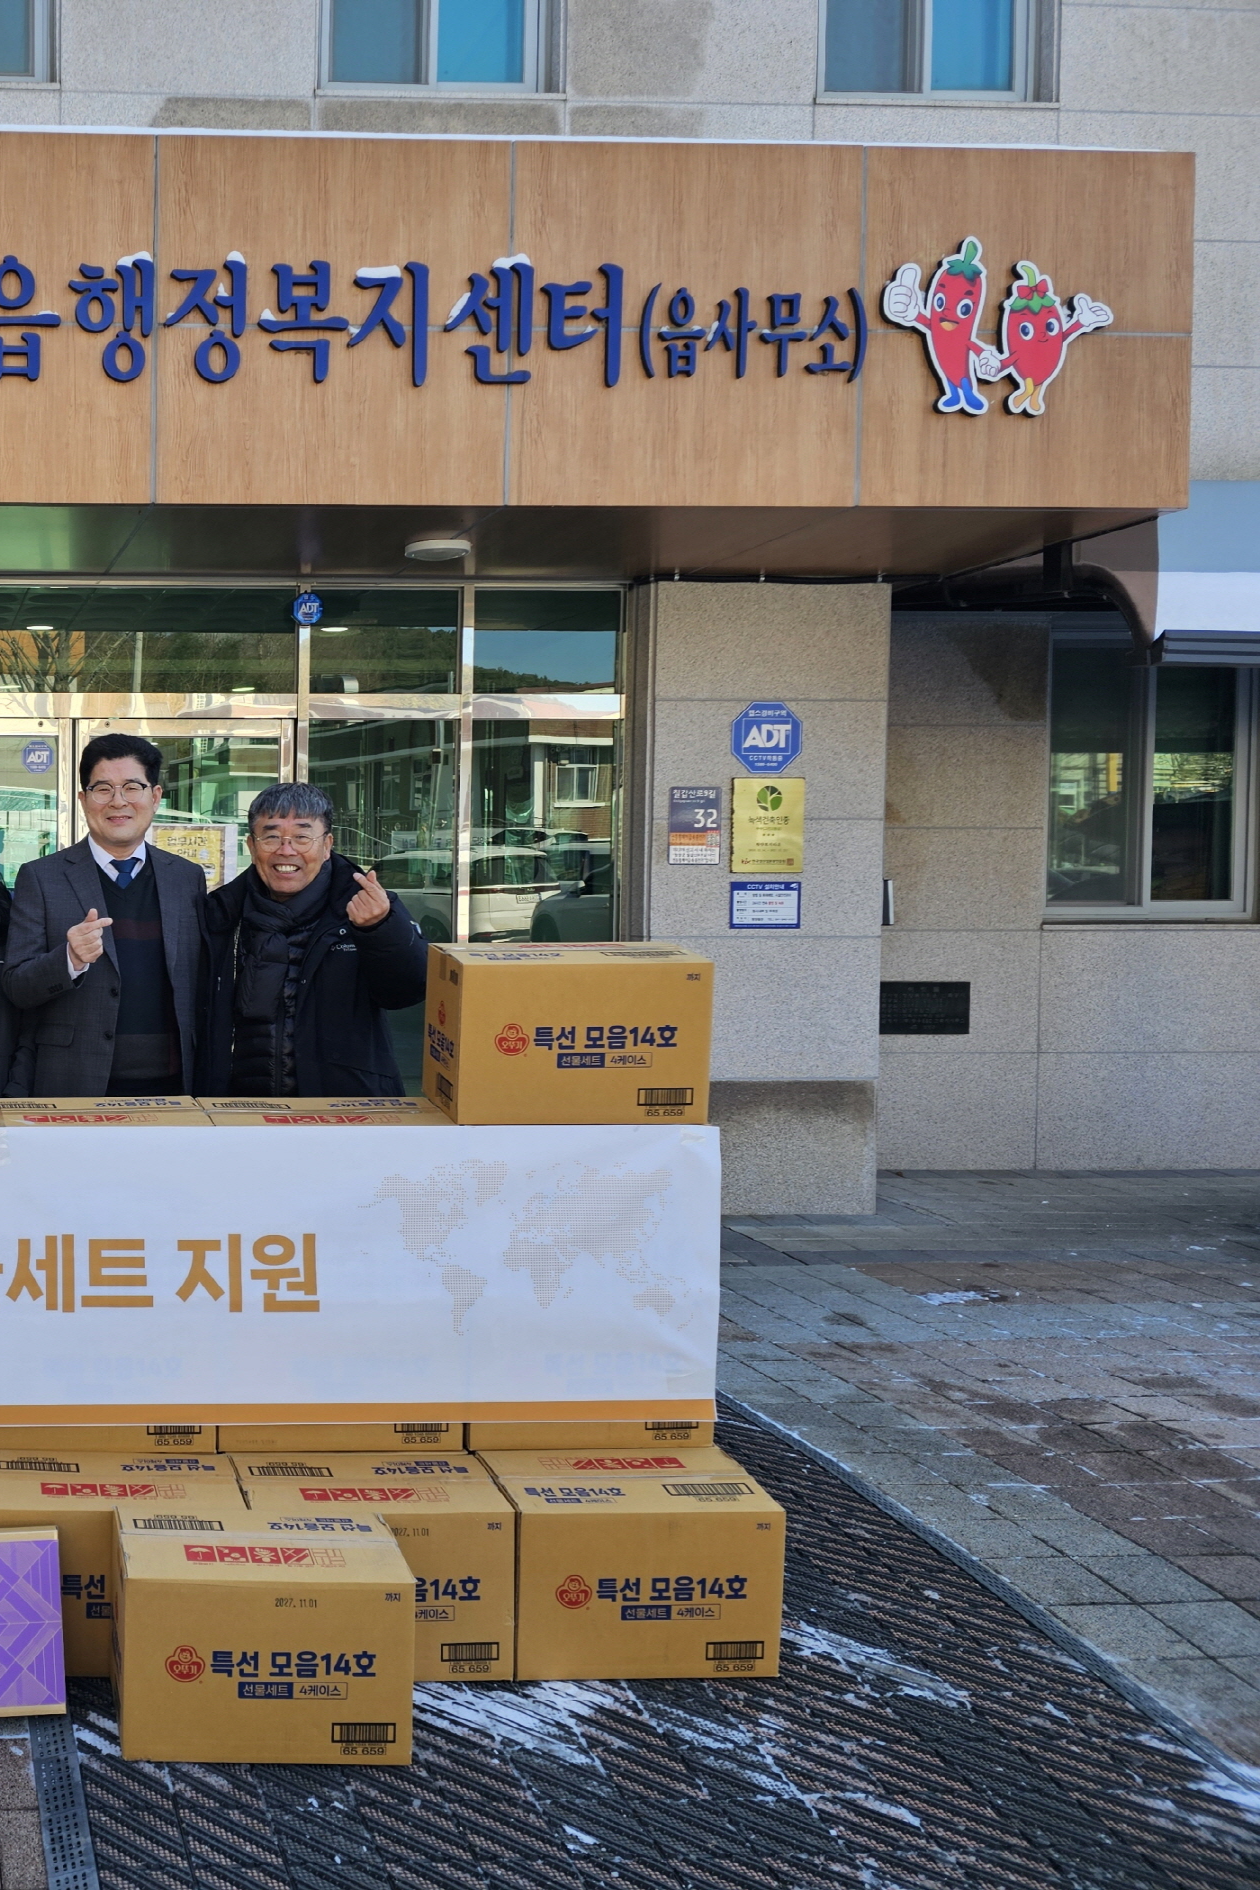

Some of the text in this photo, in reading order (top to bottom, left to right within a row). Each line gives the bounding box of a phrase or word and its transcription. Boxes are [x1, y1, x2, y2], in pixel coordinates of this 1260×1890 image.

[639, 280, 867, 383] (읍사무소)
[299, 602, 320, 614] ADT
[743, 724, 791, 748] ADT
[26, 751, 49, 763] ADT
[672, 789, 716, 799] 칠갑산로9길
[693, 809, 718, 828] 32
[748, 816, 790, 825] 녹색건축인증
[533, 1025, 678, 1050] 특선 모음14호
[561, 1055, 647, 1066] 선물세트 4케이스
[646, 1109, 683, 1117] 65 659
[175, 1233, 320, 1313] 지원
[173, 1438, 193, 1446] 659
[654, 1433, 667, 1441] 65
[524, 1487, 626, 1497] 특선 모음14호
[757, 1523, 771, 1531] 까지
[61, 1575, 105, 1600] 특선
[596, 1575, 747, 1602] 특선 모음14호
[385, 1593, 401, 1602] 까지
[625, 1608, 715, 1619] 선물세트 4케이스
[173, 1664, 197, 1675] 오뚜기
[210, 1651, 377, 1678] 특선 모음14호
[452, 1665, 490, 1673] 65 659
[733, 1663, 754, 1671] 659
[242, 1684, 342, 1697] 선물세트 4케이스
[342, 1747, 385, 1755] 65 659
